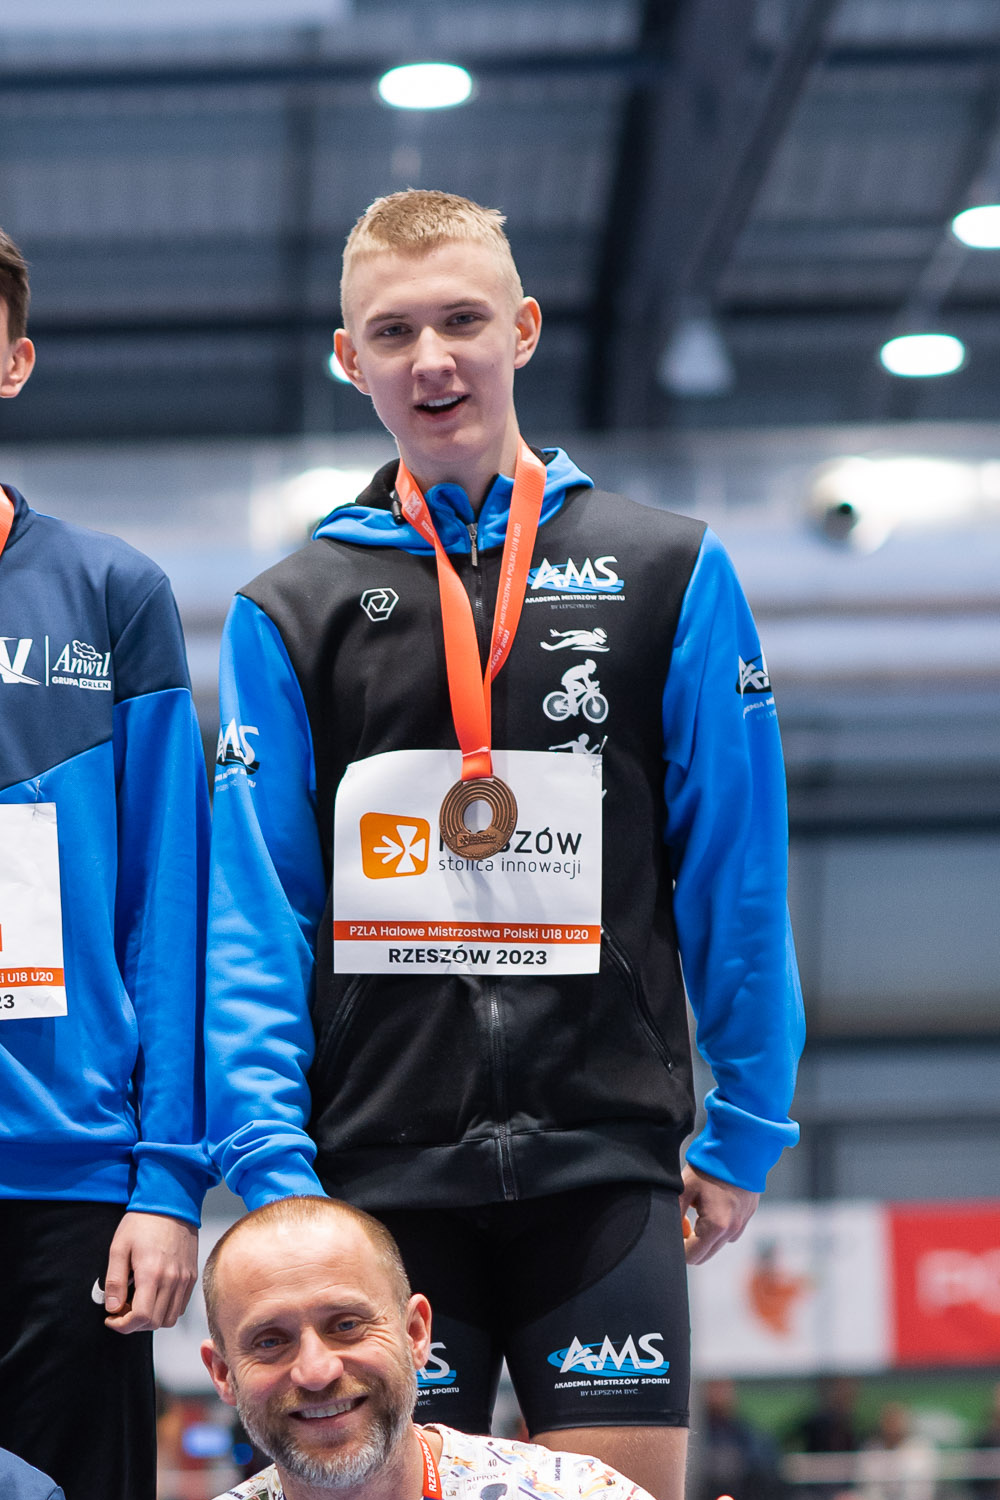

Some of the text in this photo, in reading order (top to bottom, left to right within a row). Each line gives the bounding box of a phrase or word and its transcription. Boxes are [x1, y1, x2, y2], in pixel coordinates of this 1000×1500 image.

[531, 555, 618, 590] AMS
[525, 595, 560, 604] AKADEMIA
[52, 643, 111, 677] Anwil
[52, 676, 109, 689] GRUPA ORLEN
[438, 857, 582, 880] stolica innowacji
[349, 925, 589, 940] PZLA Halowe Mistrzostwa Polski U18 U20
[388, 944, 548, 966] RZESZÓW 2023
[7, 972, 28, 983] U18
[31, 971, 54, 982] U20
[560, 1333, 664, 1373] AMS
[554, 1380, 592, 1389] AKADEMIA
[593, 1378, 639, 1386] MISTRZÓW
[432, 1387, 460, 1395] SPORTU
[488, 1459, 497, 1467] 40
[466, 1473, 499, 1483] NIPPON
